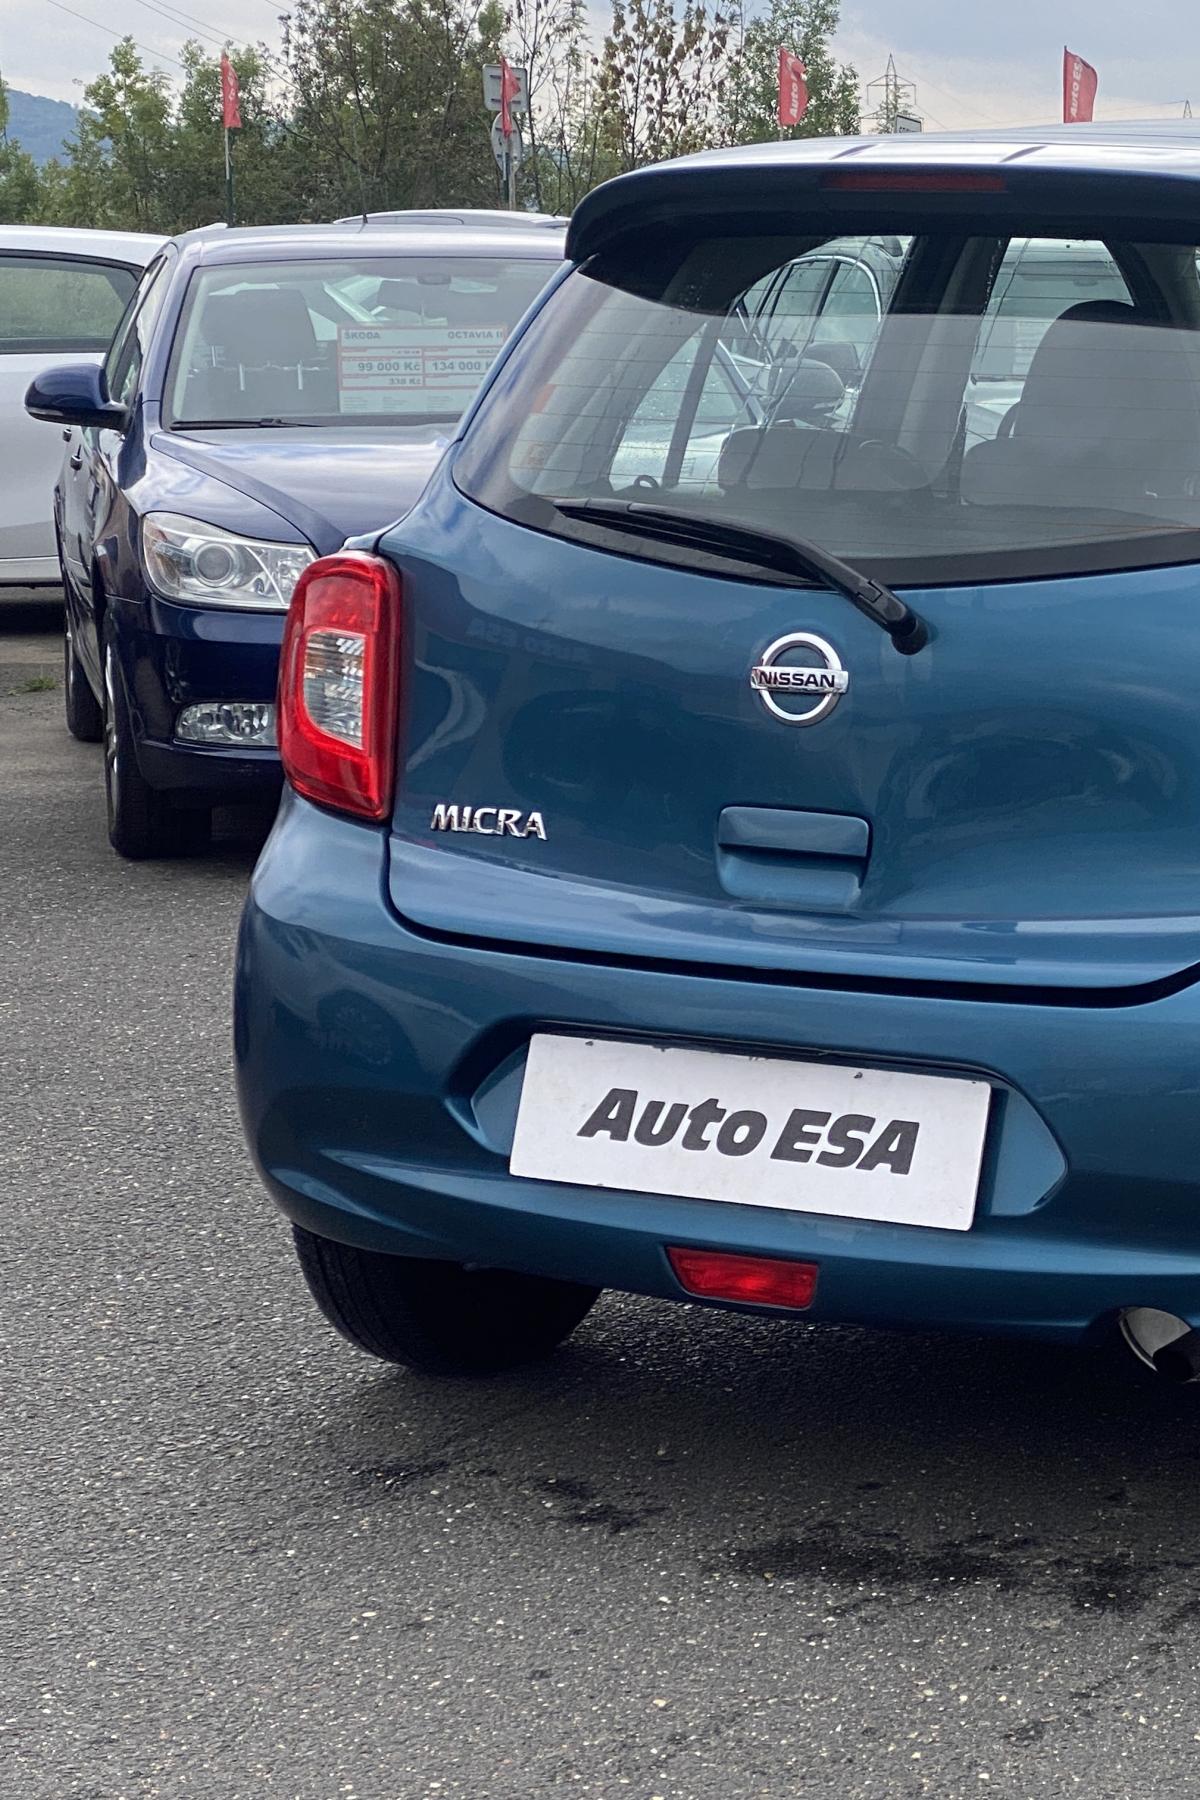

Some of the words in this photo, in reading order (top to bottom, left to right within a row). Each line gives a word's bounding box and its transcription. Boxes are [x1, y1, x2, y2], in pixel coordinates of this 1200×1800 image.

[789, 82, 799, 119] Auto
[1070, 81, 1080, 118] Auto
[447, 331, 494, 339] OCTAVIA
[358, 361, 373, 371] 99
[377, 361, 399, 371] 000
[432, 361, 455, 371] 134
[458, 361, 481, 371] 000
[759, 670, 835, 688] NISSAN
[430, 804, 547, 840] MICRA
[576, 1087, 767, 1157] Auto
[770, 1108, 920, 1175] ESA
